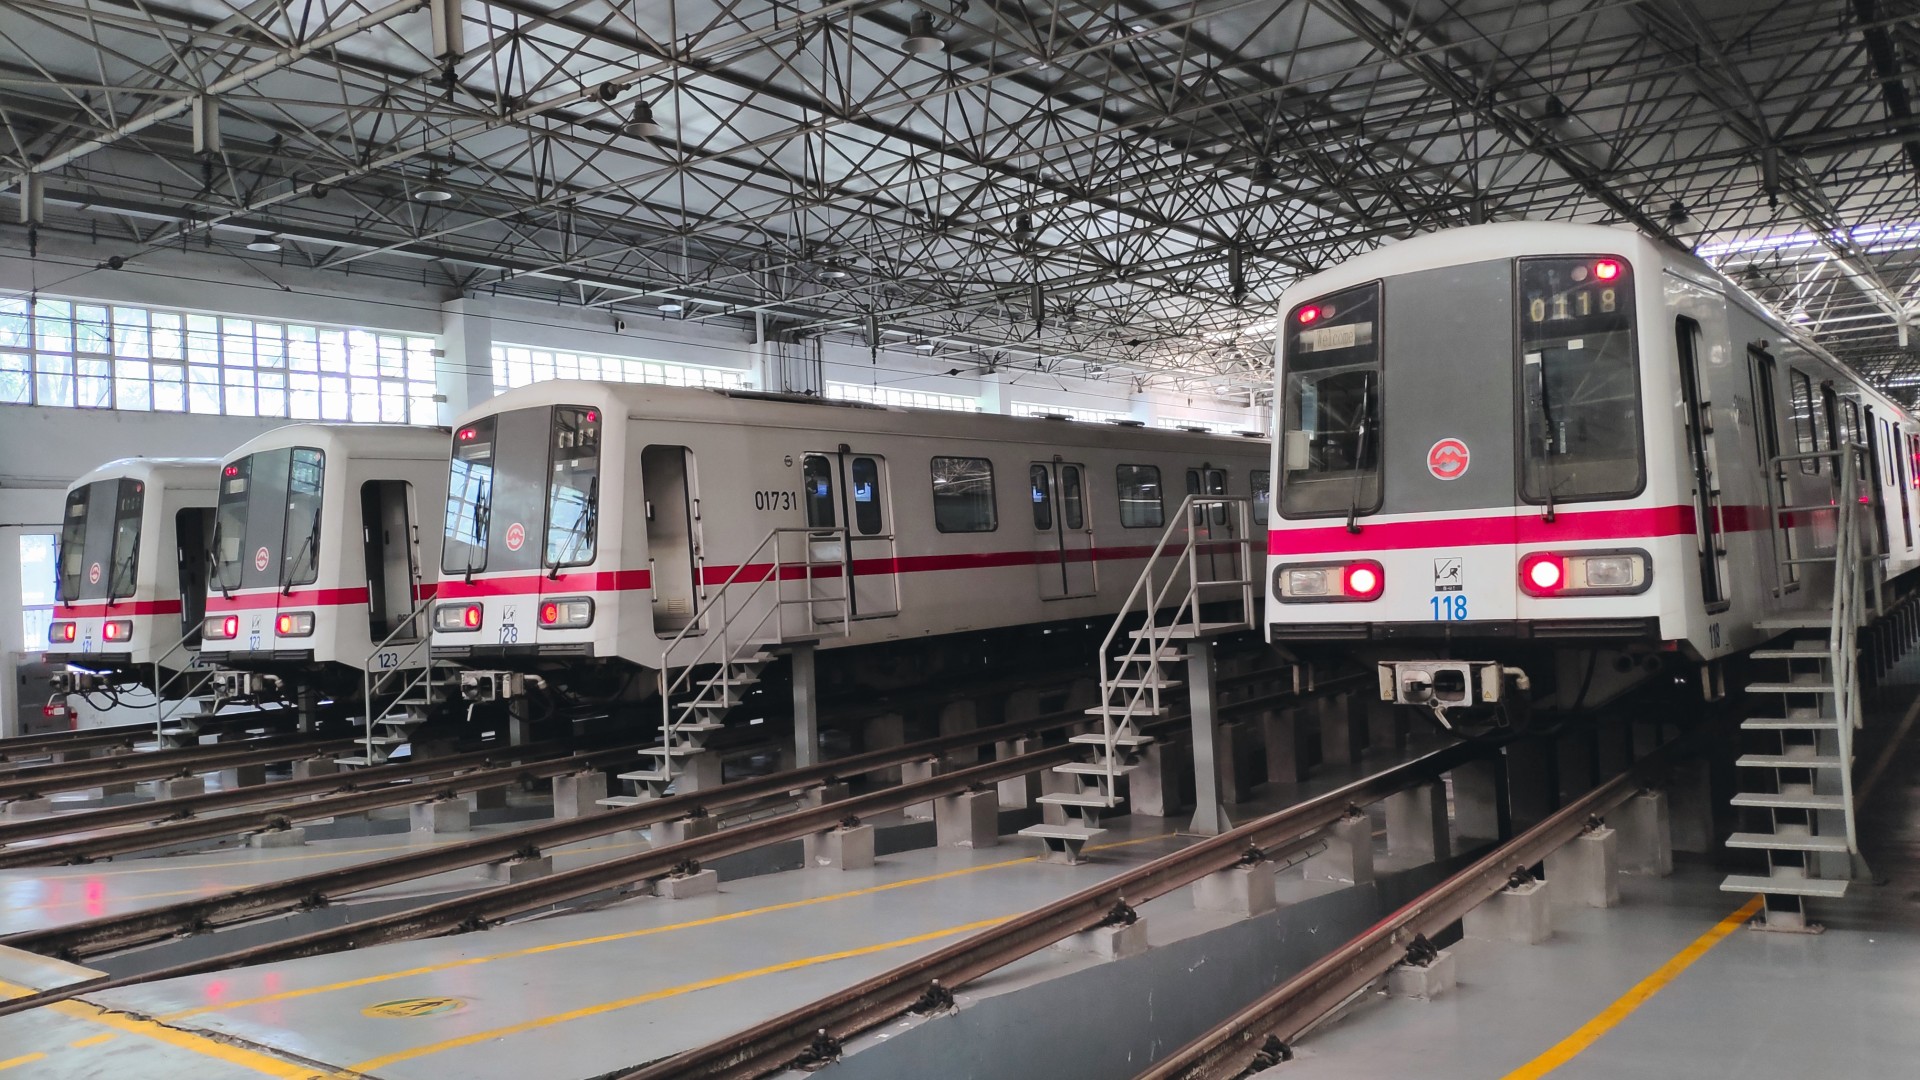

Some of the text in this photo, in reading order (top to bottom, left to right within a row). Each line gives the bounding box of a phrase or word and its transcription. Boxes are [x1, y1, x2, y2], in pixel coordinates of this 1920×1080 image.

[1316, 328, 1355, 348] Welcome
[755, 491, 797, 511] 01731
[1430, 594, 1468, 621] 118
[499, 627, 518, 645] 128
[378, 652, 398, 668] 123
